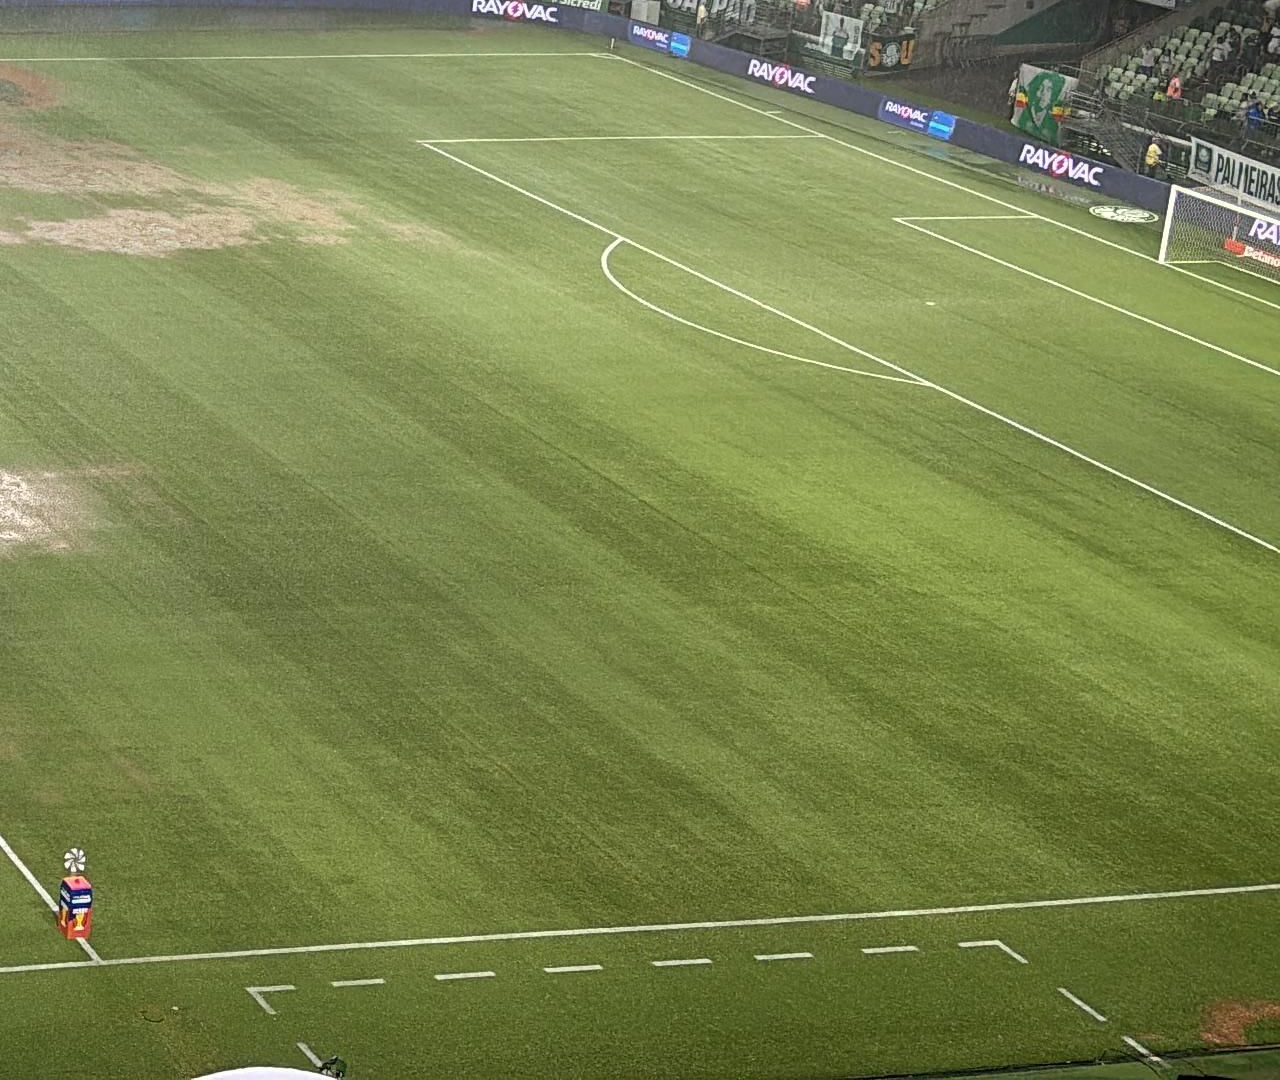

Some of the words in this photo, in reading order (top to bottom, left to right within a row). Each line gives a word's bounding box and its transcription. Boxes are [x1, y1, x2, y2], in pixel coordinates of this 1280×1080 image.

[633, 25, 670, 44] RAYOVAC
[748, 58, 817, 94] RAYOVAC
[886, 100, 929, 123] RAYOVAC
[1020, 142, 1104, 187] RAYOVAC
